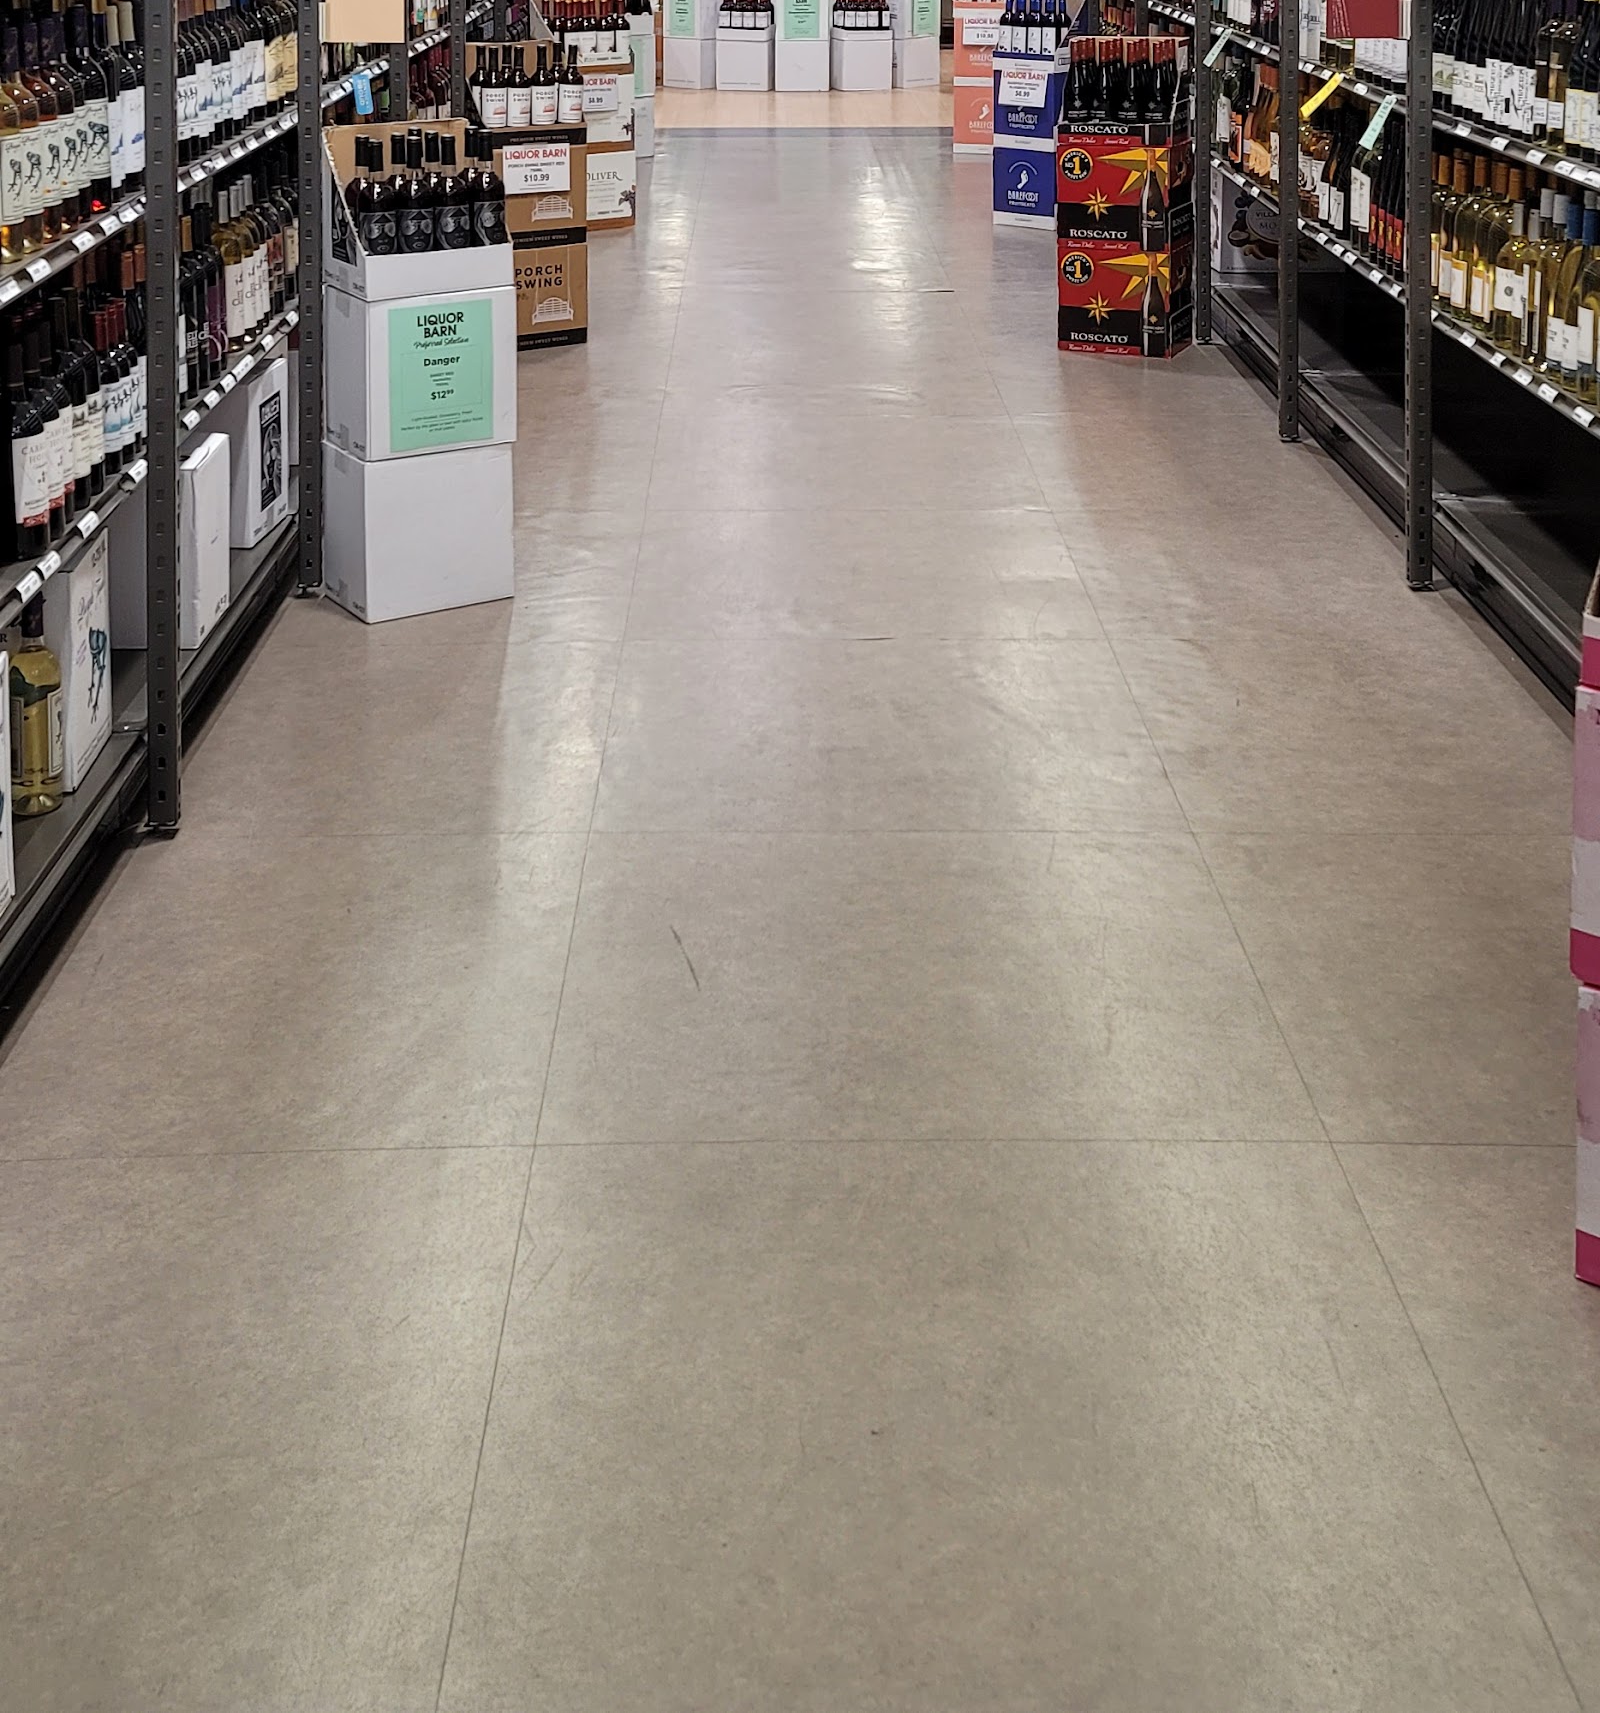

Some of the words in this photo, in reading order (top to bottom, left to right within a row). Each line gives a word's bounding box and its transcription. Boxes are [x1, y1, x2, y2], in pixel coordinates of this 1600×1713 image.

[1003, 70, 1026, 79] LIQUOR
[1028, 72, 1046, 81] BARN
[600, 78, 617, 86] BARN
[1070, 125, 1129, 135] ROSCATO
[505, 149, 540, 160] LIQUOR
[542, 148, 567, 158] BARN
[1072, 156, 1081, 174] 1
[524, 173, 550, 183] $10.99
[1007, 190, 1038, 203] BAREFOOT
[1069, 228, 1128, 239] ROSCATO
[515, 264, 563, 278] PORCH
[1073, 260, 1082, 278] 1
[515, 276, 563, 290] SWING
[417, 311, 464, 327] LIQUOR
[424, 324, 457, 338] BARN
[413, 338, 443, 349] Preferred
[444, 336, 469, 346] Selection
[1070, 332, 1128, 343] ROSCATO
[424, 356, 460, 367] Danger
